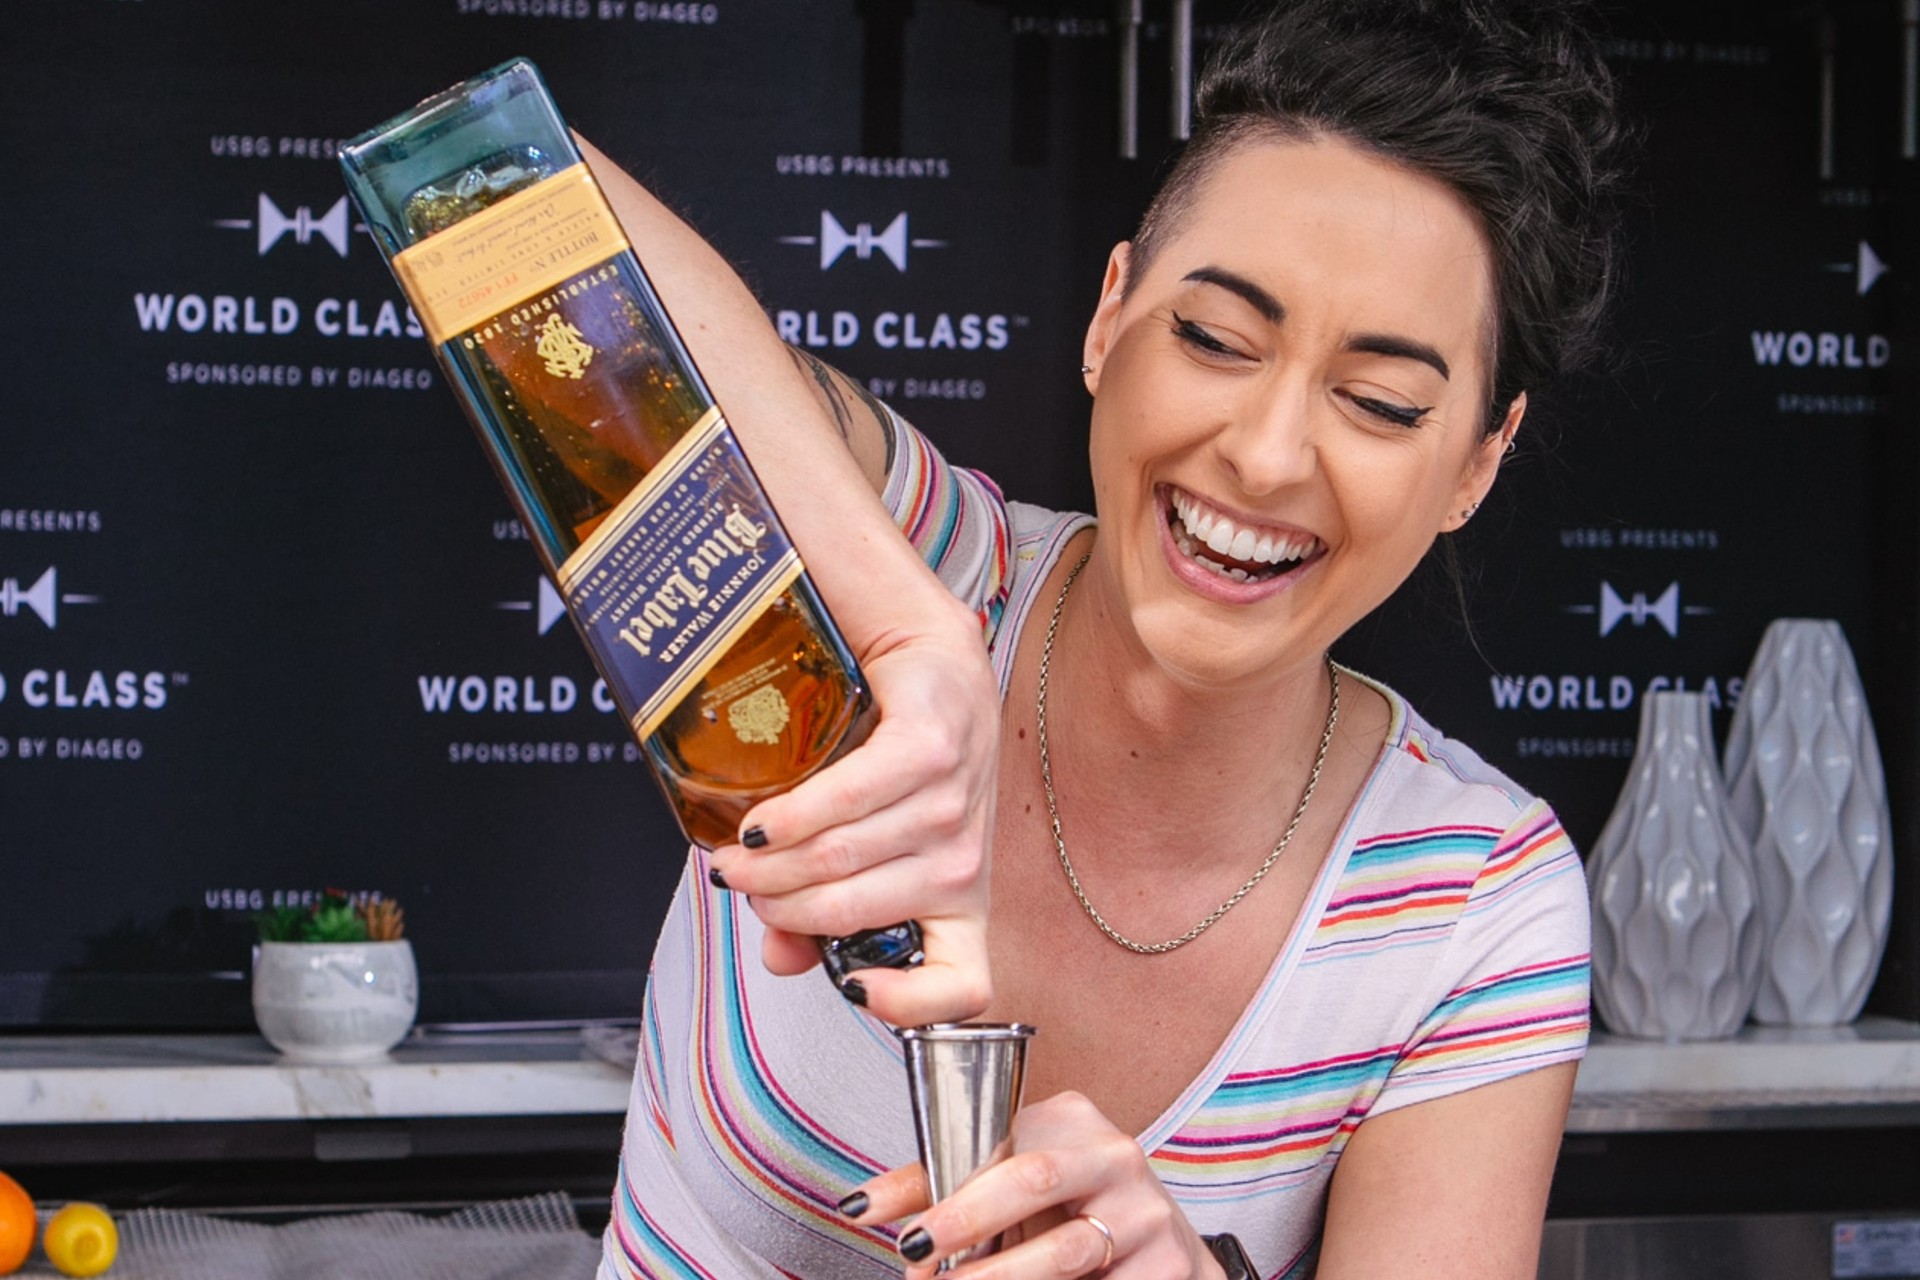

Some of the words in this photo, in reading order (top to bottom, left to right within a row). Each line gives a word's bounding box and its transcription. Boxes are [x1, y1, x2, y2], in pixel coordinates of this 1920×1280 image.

[457, 0, 590, 19] SPONSORED
[599, 0, 625, 19] BY
[635, 1, 718, 24] DIAGEO
[211, 136, 271, 157] USBG
[777, 155, 834, 175] USBG
[841, 156, 949, 177] PRESENTS
[549, 231, 599, 262] BOTTLE
[510, 264, 619, 325] ESTABLISHED
[135, 293, 299, 334] WORLD
[314, 299, 424, 338] CLAS
[464, 323, 503, 349] 1820
[1752, 332, 1888, 367] WORLD
[167, 362, 301, 386] SPONSORED
[311, 367, 338, 386] BY
[348, 368, 432, 389] DIAGEO
[868, 378, 896, 399] BY
[904, 378, 985, 399] DIAGEO
[650, 501, 671, 523] OUR
[682, 502, 724, 545] BLENDED
[610, 526, 648, 567] RAREST
[687, 503, 766, 580] Blue
[1561, 529, 1613, 547] USBG
[1620, 529, 1718, 548] PRESENTS
[646, 546, 682, 584] SCOTCH
[708, 548, 766, 612] JOHNNIE
[610, 584, 647, 623] WHISKY
[619, 566, 708, 656] Label
[659, 611, 714, 662] WALKER
[418, 676, 577, 712] WORLD
[1491, 675, 1633, 709] WORLD
[19, 737, 46, 758] BY
[57, 738, 142, 759] DIAGEO
[449, 743, 579, 763] SPONSORED
[588, 743, 614, 762] BY
[205, 889, 263, 909] USBG
